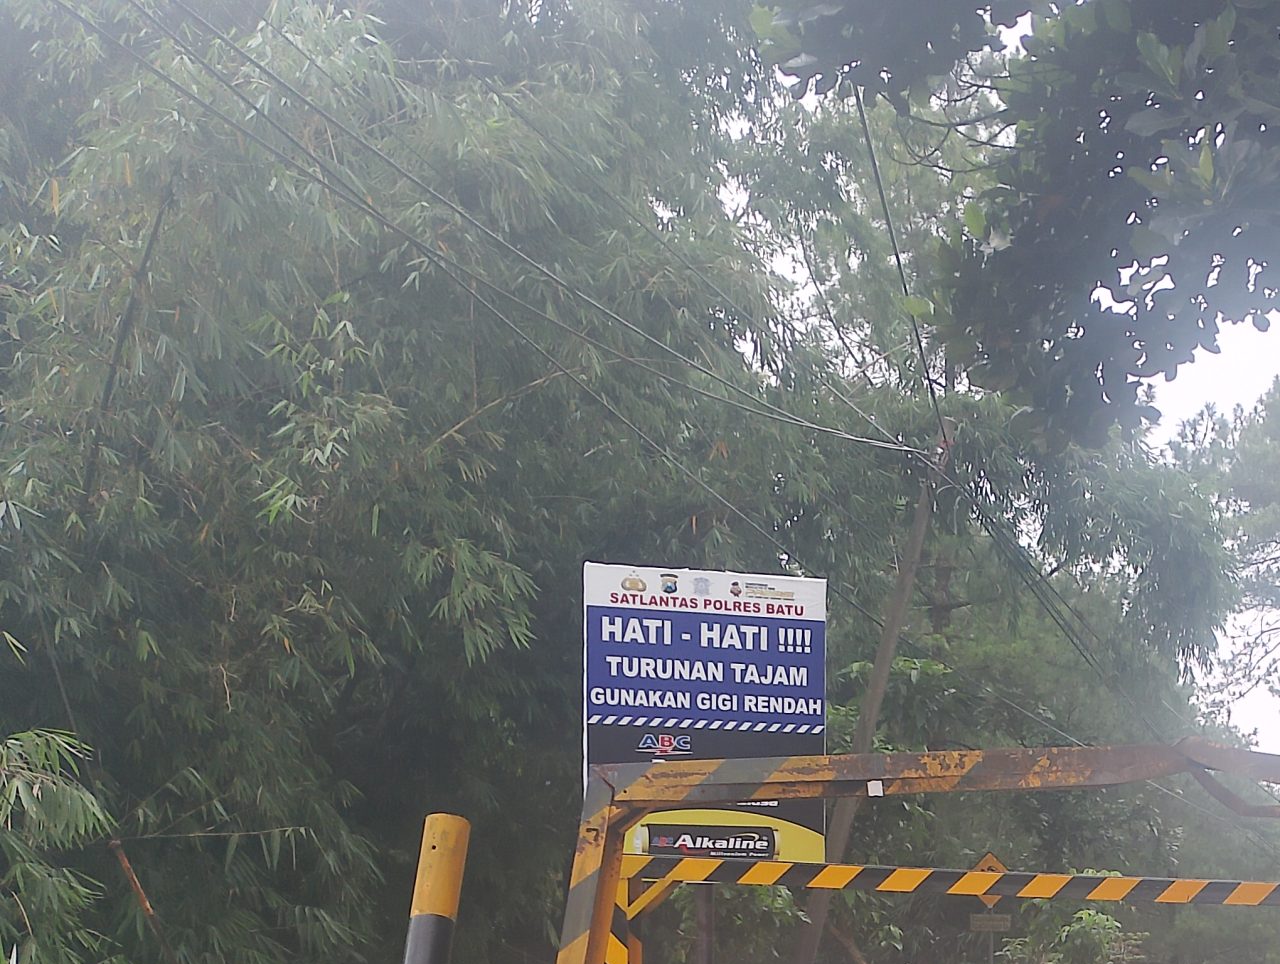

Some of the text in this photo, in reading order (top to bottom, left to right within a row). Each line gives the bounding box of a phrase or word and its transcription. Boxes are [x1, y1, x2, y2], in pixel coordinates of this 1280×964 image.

[610, 593, 805, 616] SATLANTAS POLRES BATU
[601, 616, 672, 645] HATI
[700, 623, 768, 651] HATI
[778, 627, 811, 653] !!!!
[606, 656, 808, 686] TURUNAN TAJAM
[590, 687, 822, 715] GUNAKAN GIGI RENDAH
[638, 734, 691, 750] ABC
[674, 834, 769, 849] Alkaline
